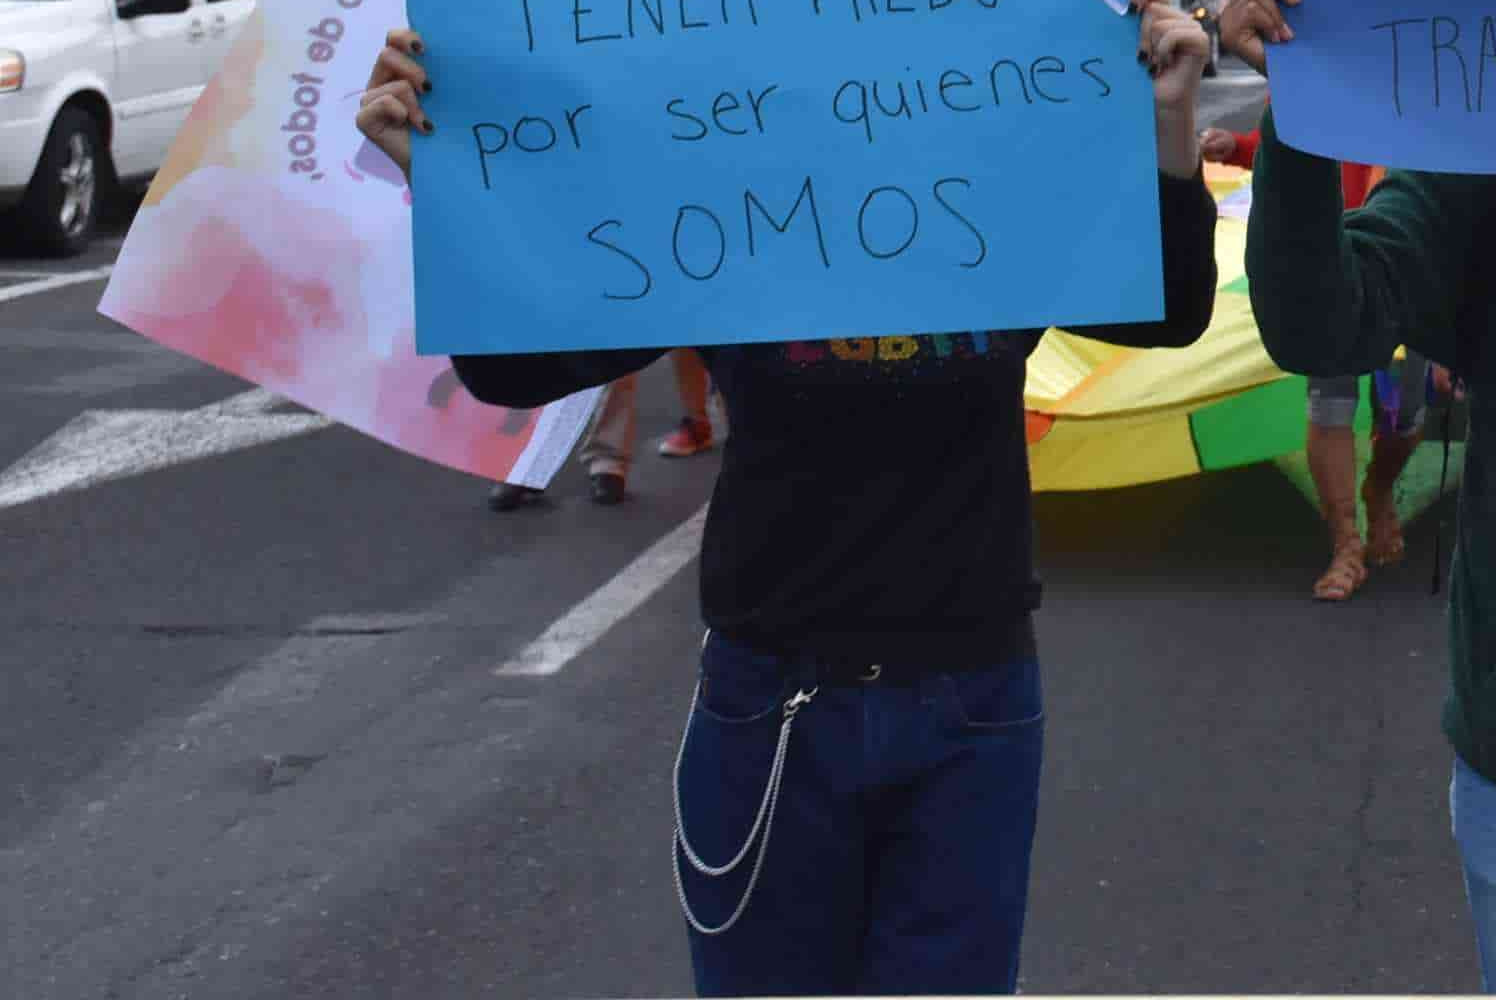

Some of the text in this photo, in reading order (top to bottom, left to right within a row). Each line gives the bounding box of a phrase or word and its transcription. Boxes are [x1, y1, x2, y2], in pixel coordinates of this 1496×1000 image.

[472, 56, 1111, 190] por ser quienes
[586, 176, 986, 300] SOMOS
